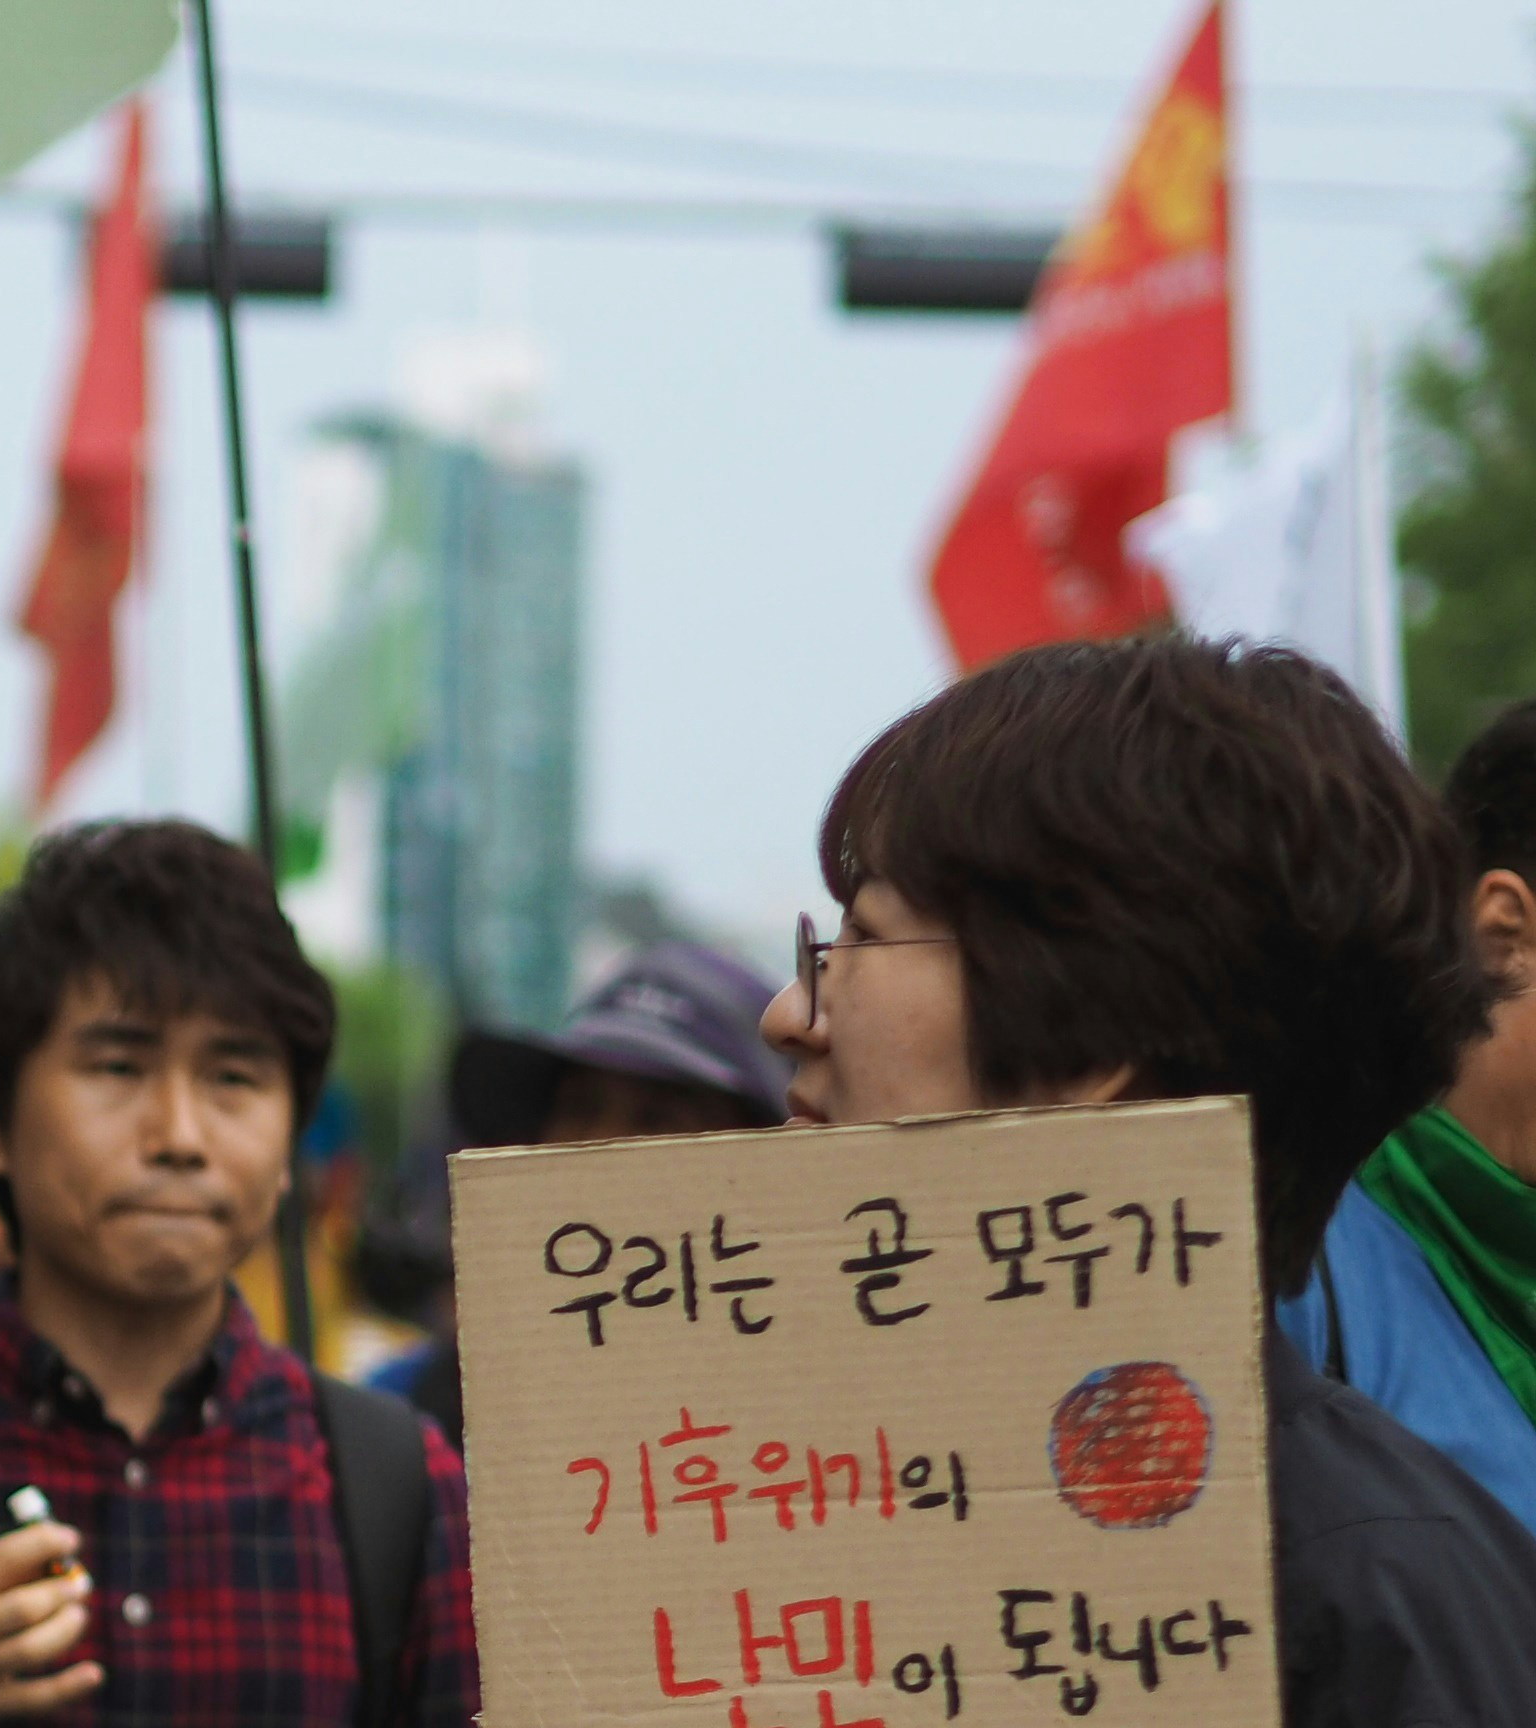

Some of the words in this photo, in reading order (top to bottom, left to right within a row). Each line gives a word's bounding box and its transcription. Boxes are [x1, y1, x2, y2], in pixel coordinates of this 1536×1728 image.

[544, 1214, 776, 1347] 우리는
[840, 1197, 934, 1326] 곧
[976, 1191, 1224, 1309] 모두가
[566, 1406, 969, 1544] 기후위기의
[998, 1588, 1254, 1718] 됩니다
